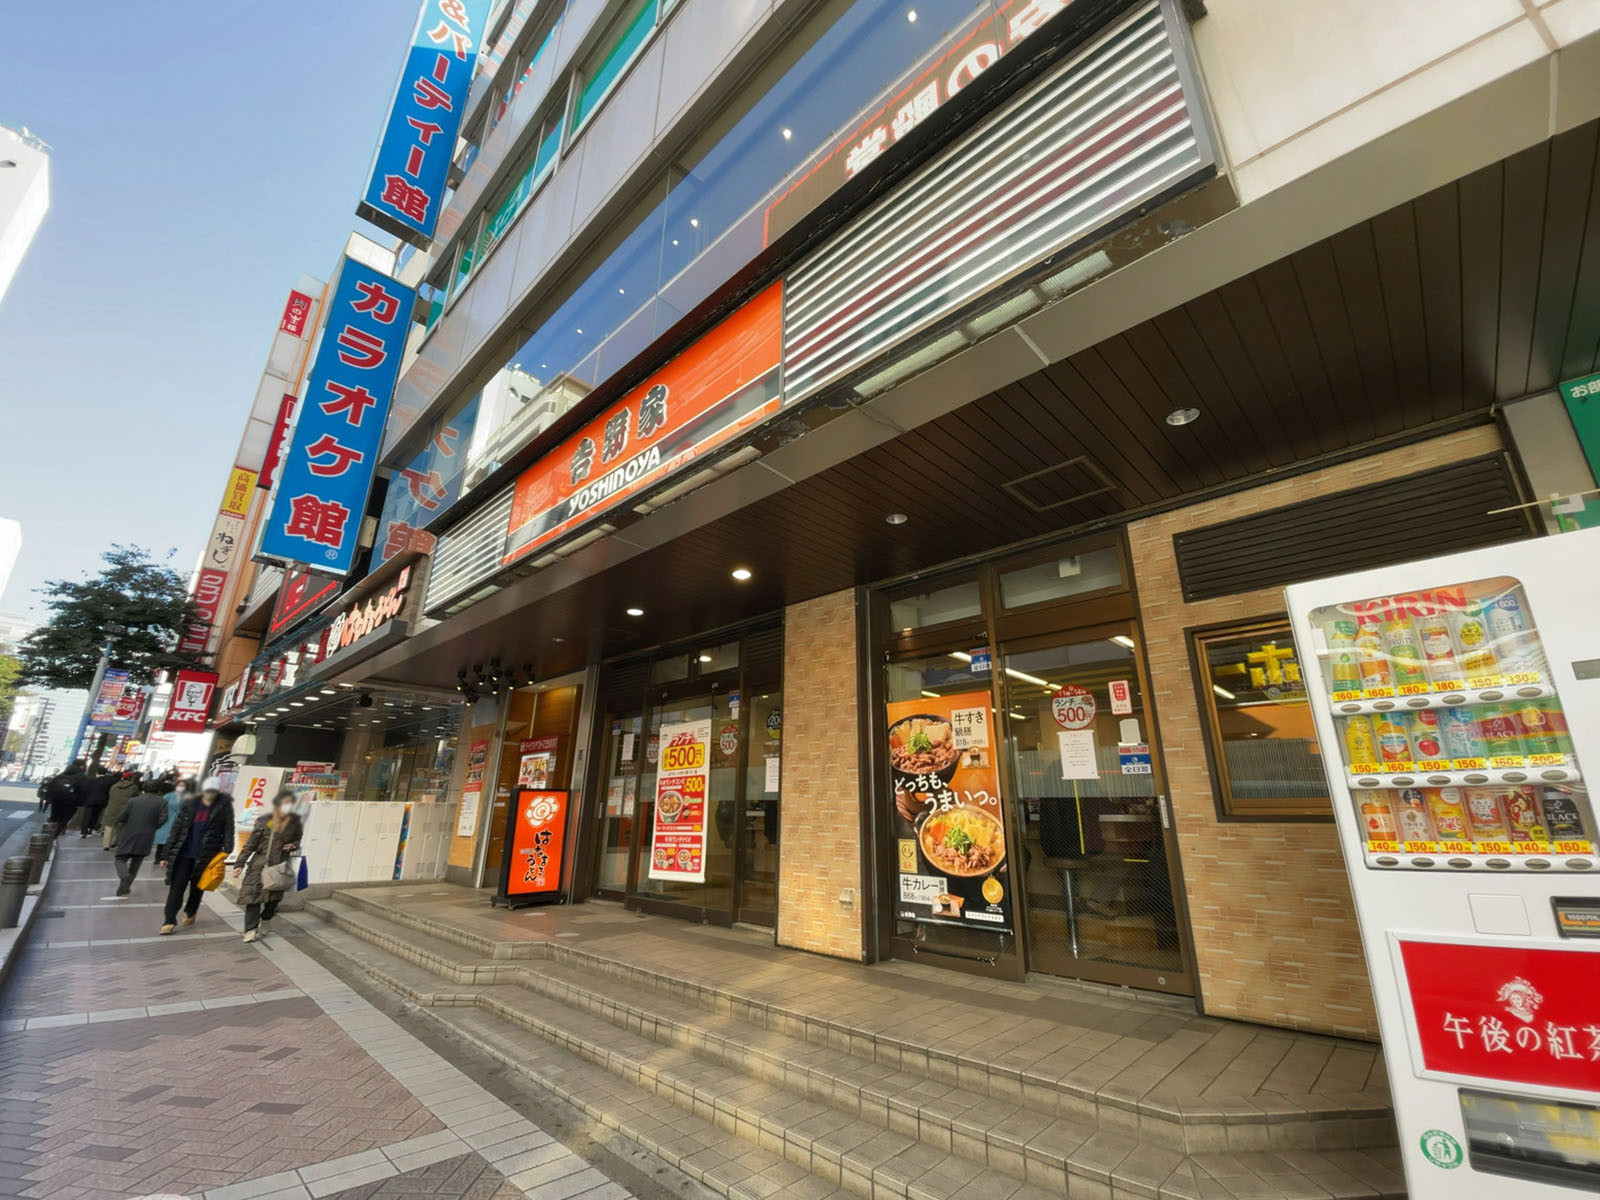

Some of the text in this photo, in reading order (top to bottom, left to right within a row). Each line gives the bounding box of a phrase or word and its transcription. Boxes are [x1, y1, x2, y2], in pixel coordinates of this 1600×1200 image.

[284, 278, 399, 549] カラオケ館
[569, 384, 668, 485] 吉野家
[229, 472, 251, 510] 高価買取
[213, 532, 234, 564] ねぎし
[1353, 588, 1469, 624] KIRIN
[169, 710, 206, 724] KFC
[954, 711, 983, 725] 牛すき
[252, 778, 267, 807] yDo
[894, 772, 948, 794] どっちも、
[924, 790, 997, 815] うまいっ。
[1546, 813, 1578, 821] BLACK
[902, 877, 938, 890] 牛カレー
